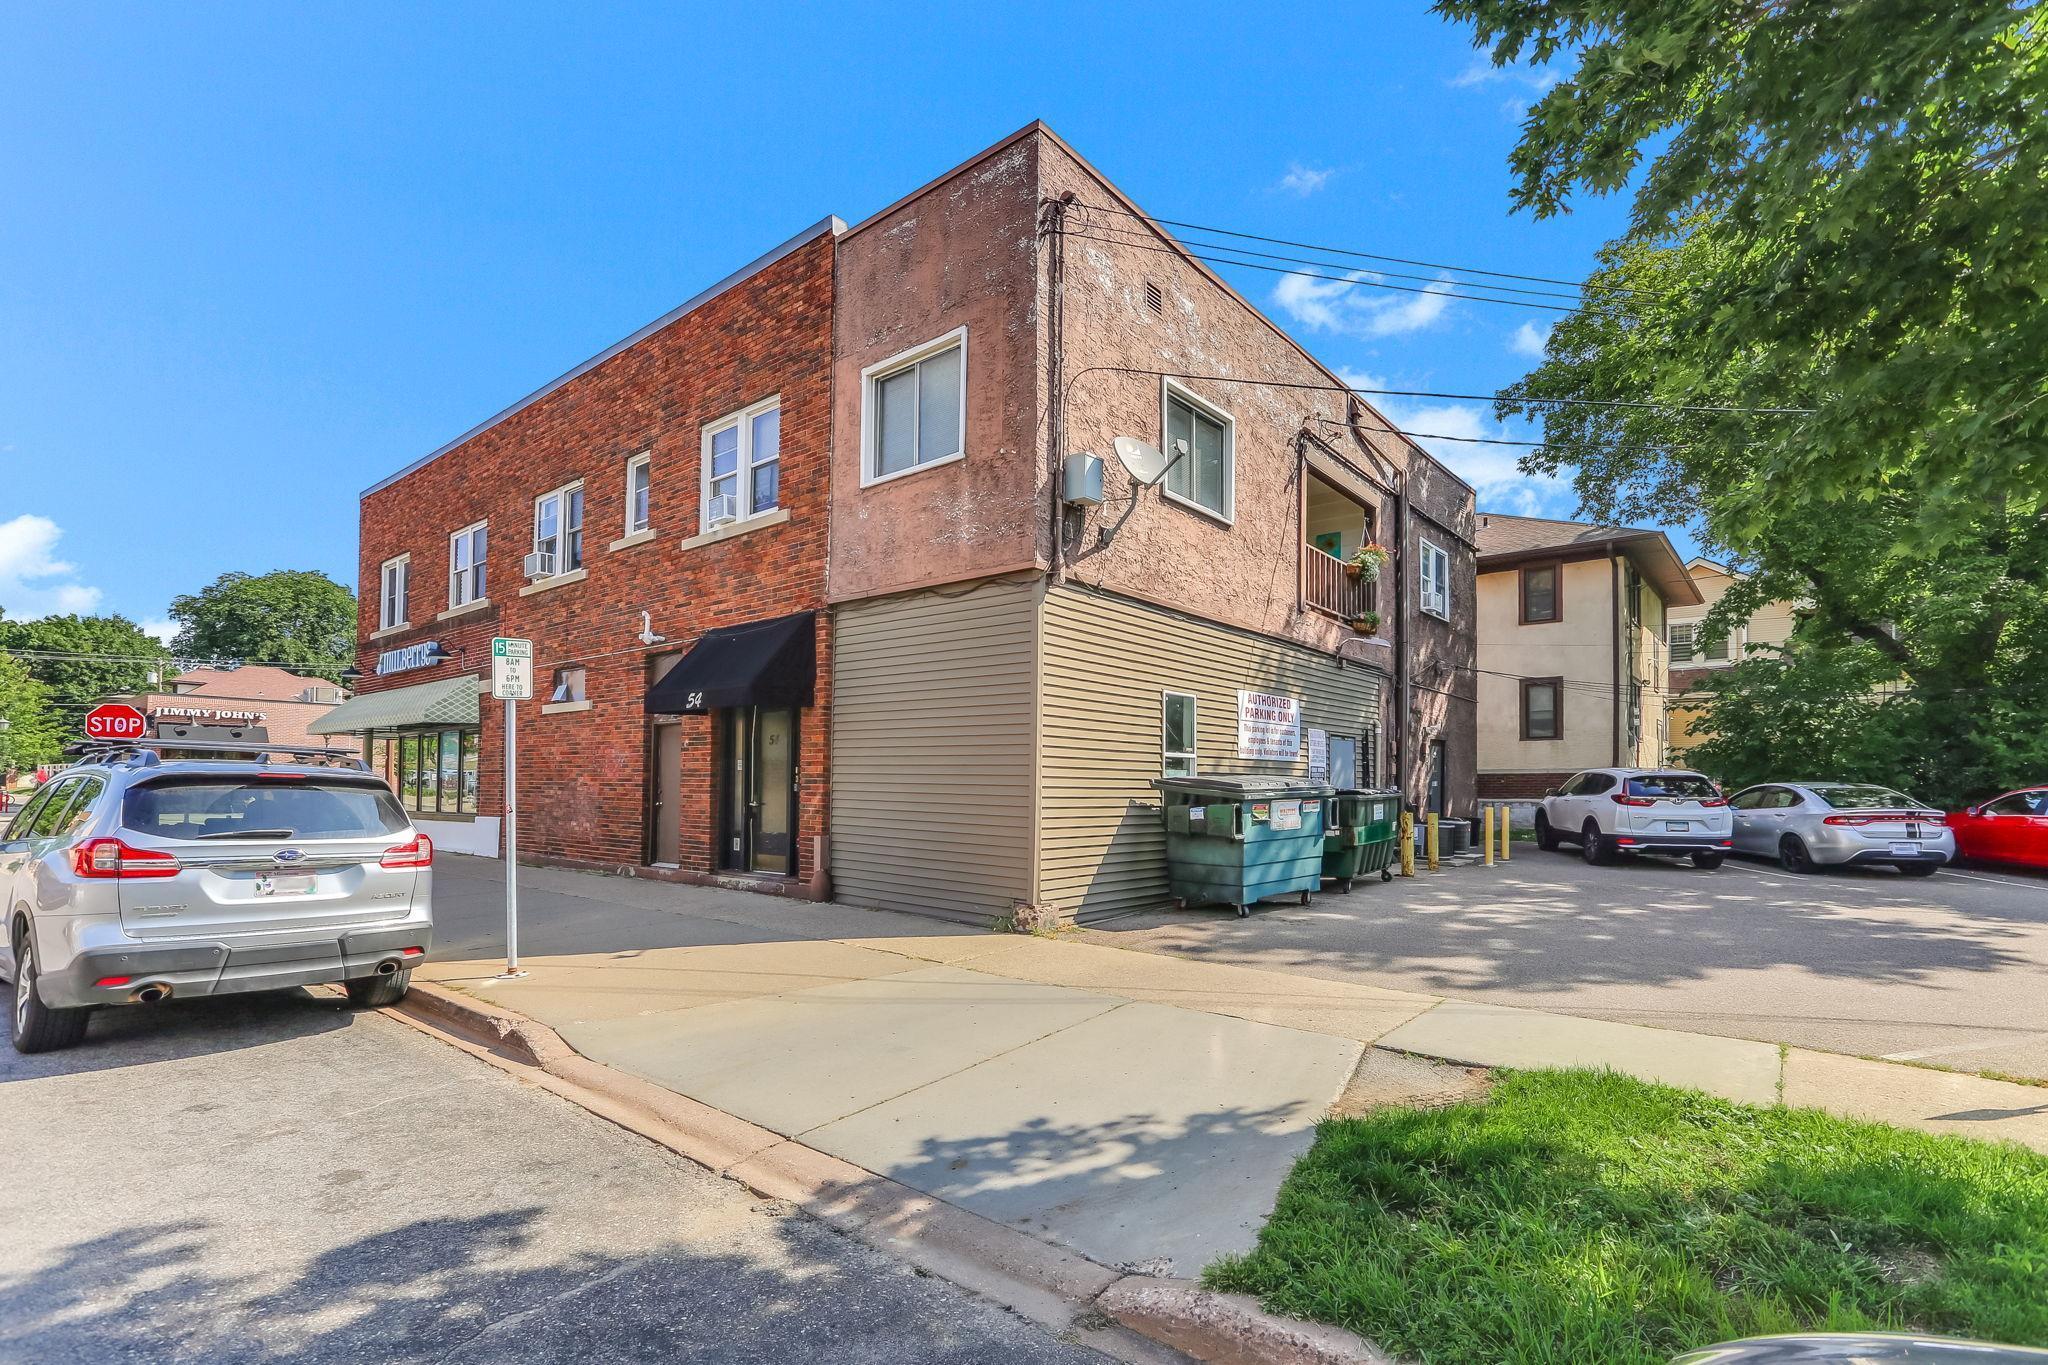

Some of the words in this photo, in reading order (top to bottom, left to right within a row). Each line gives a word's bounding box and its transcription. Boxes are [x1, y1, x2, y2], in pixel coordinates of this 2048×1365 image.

[494, 642, 506, 654] 15
[505, 657, 520, 666] 8AM
[505, 674, 520, 683] 6PM
[685, 692, 702, 708] 54
[1247, 693, 1291, 710] AUTHORIZED
[155, 706, 212, 718] JIMMY
[214, 709, 267, 721] JOHN'S
[1245, 706, 1277, 721] PARKING
[1278, 711, 1295, 724] ONLY
[89, 716, 141, 733] STOP
[1252, 726, 1265, 735] parking
[1247, 736, 1266, 746] employees
